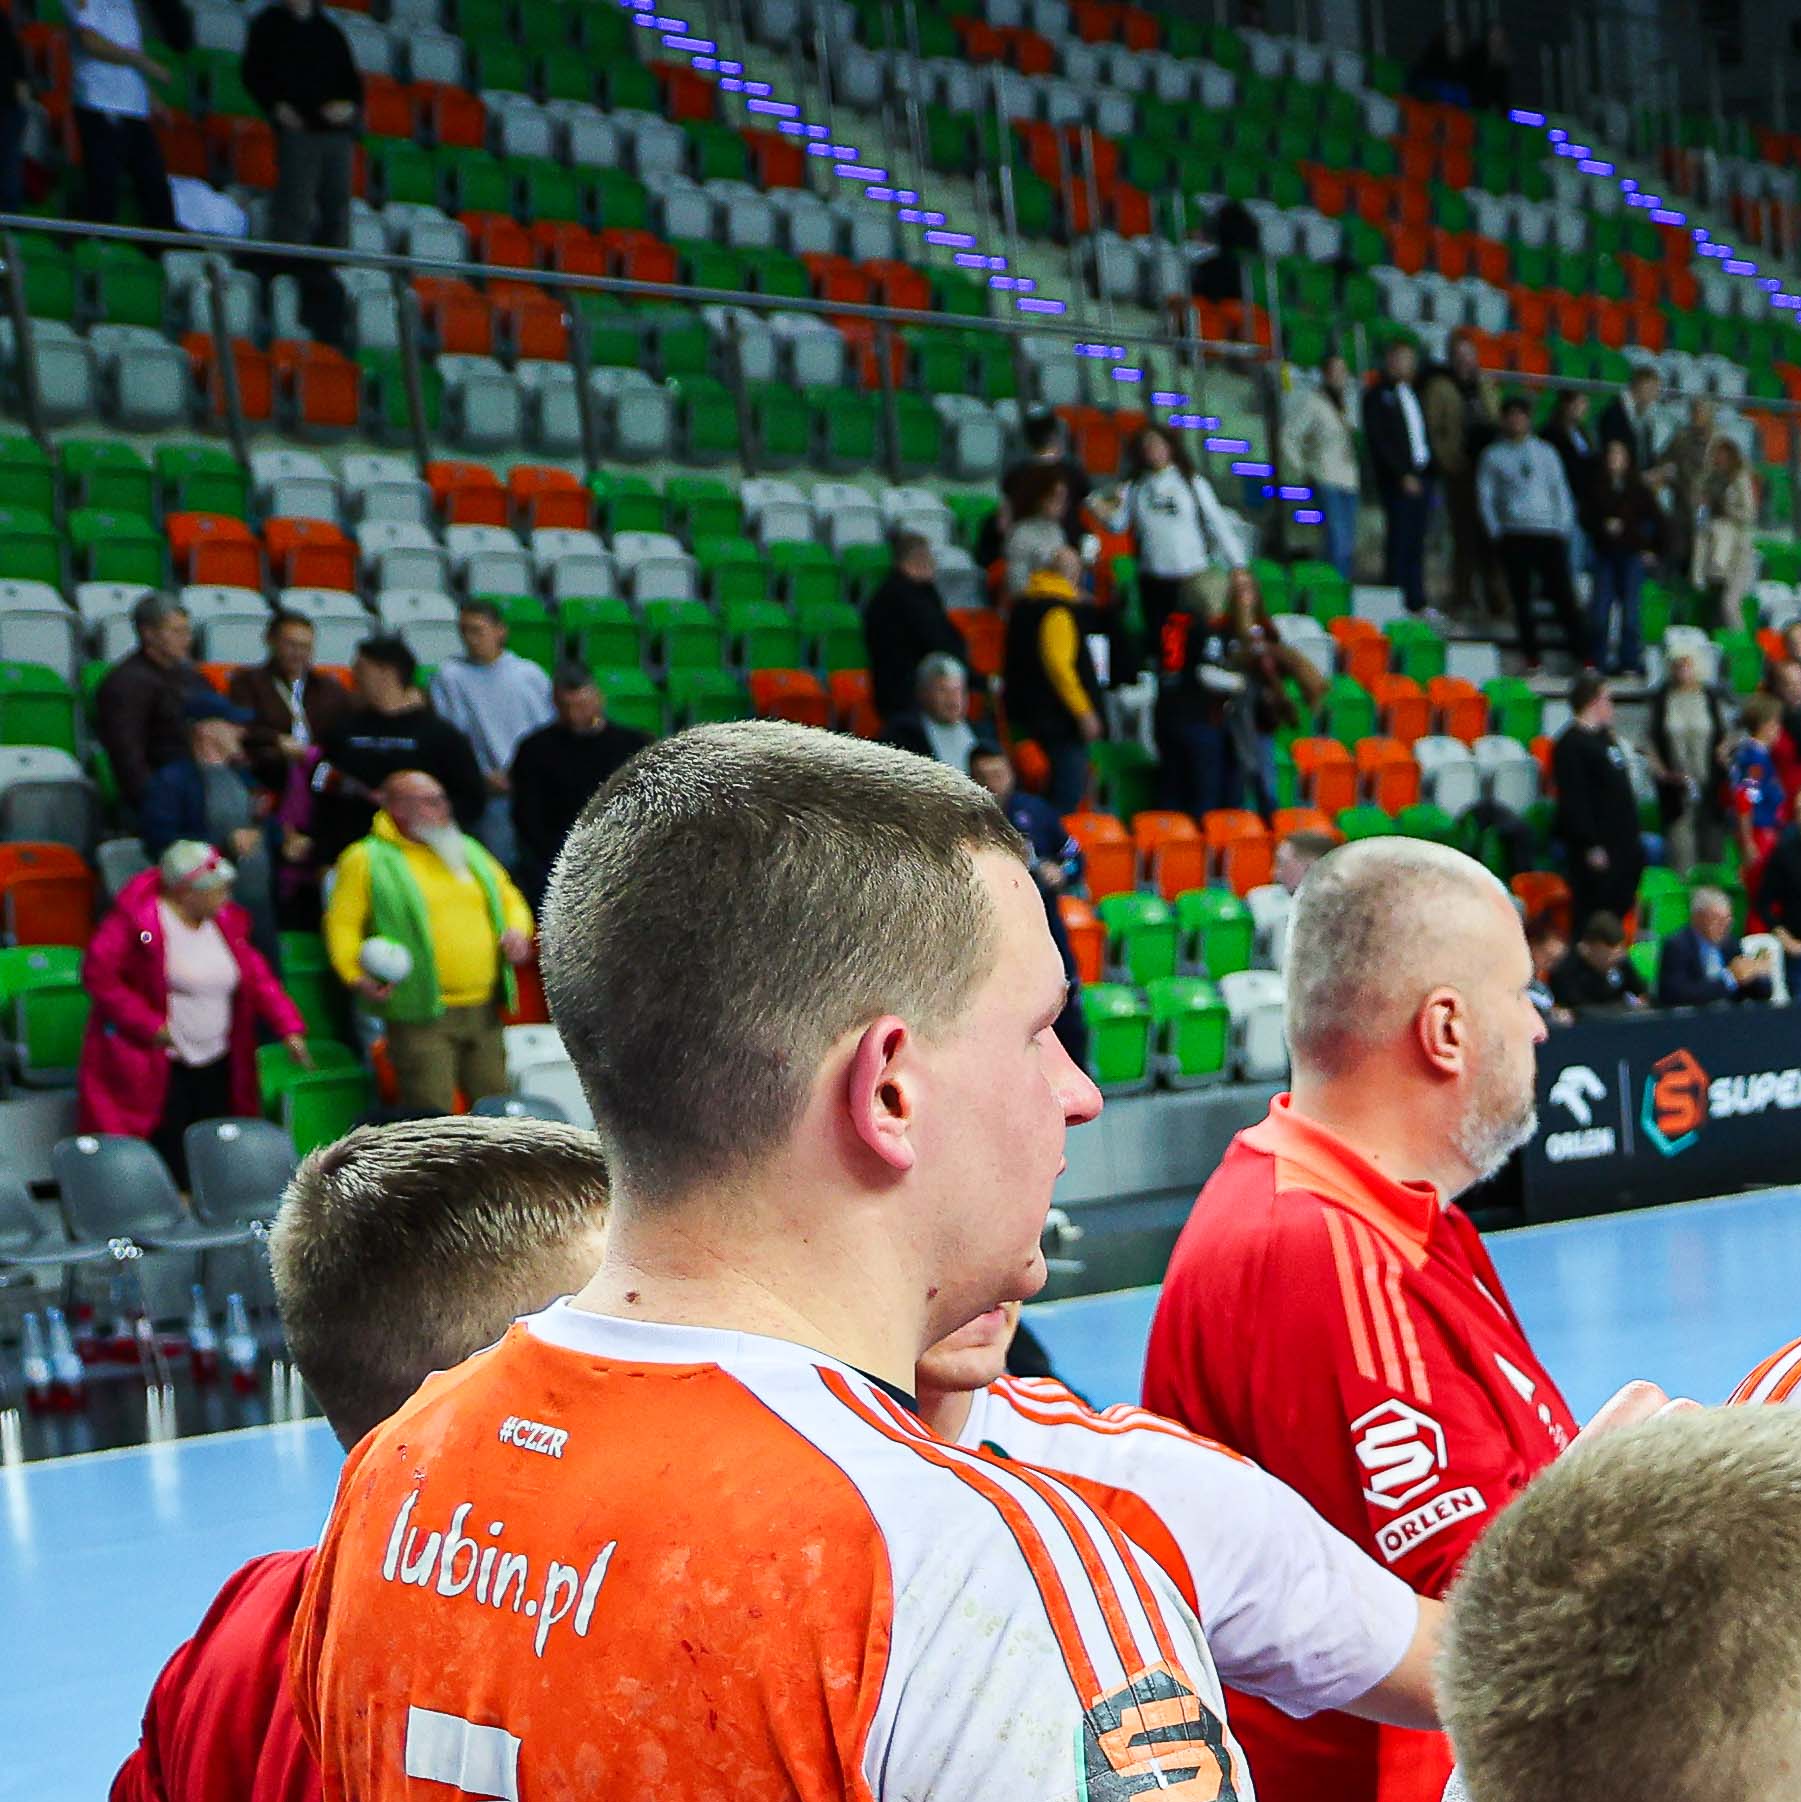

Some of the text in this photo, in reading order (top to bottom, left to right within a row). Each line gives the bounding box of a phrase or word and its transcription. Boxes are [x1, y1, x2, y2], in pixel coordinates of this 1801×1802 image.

[499, 1415, 569, 1459] #CZZR
[1383, 1490, 1474, 1552] ORLEN
[382, 1488, 617, 1659] lubin.pl
